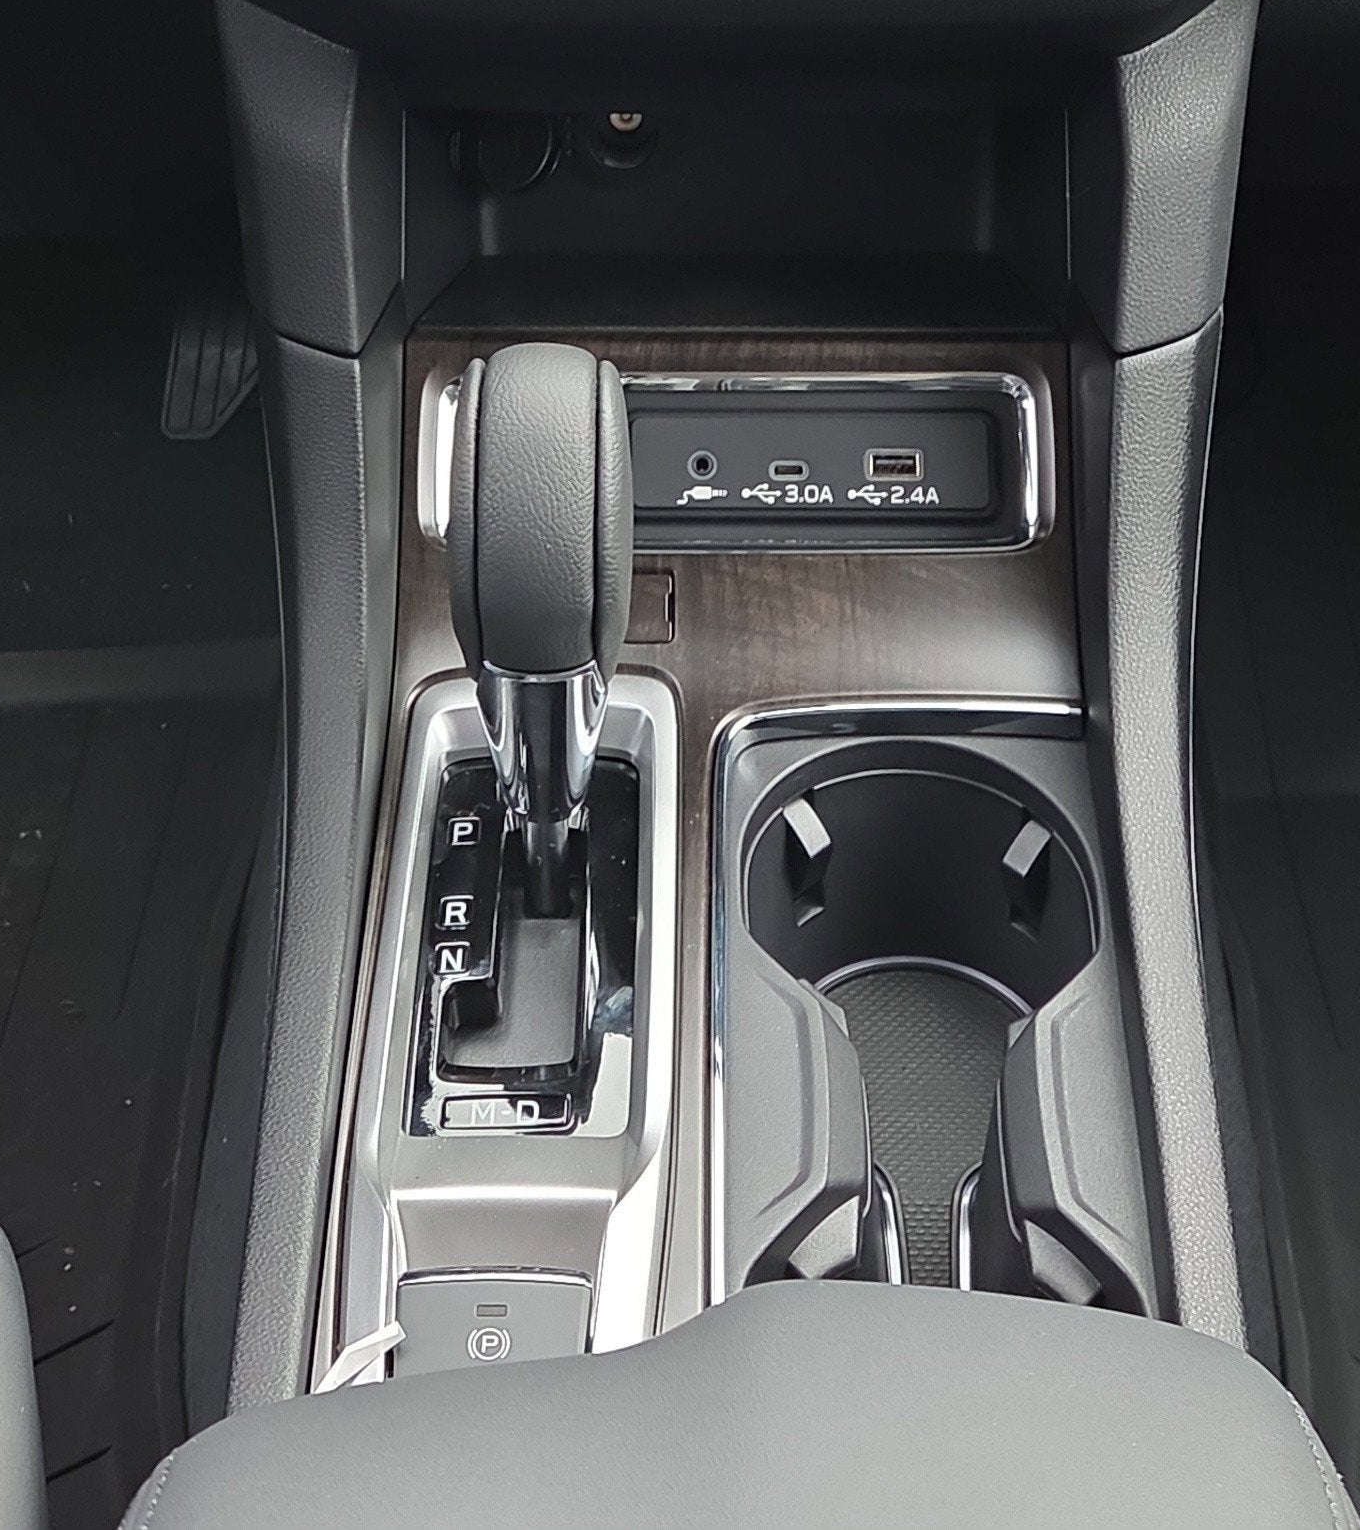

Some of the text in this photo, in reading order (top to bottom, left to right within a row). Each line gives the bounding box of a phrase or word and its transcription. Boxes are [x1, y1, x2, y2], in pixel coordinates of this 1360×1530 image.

[784, 485, 834, 504] 3.0A
[890, 485, 940, 504] 2.4A
[452, 822, 474, 843] P
[444, 902, 467, 926] R
[440, 949, 463, 971] N
